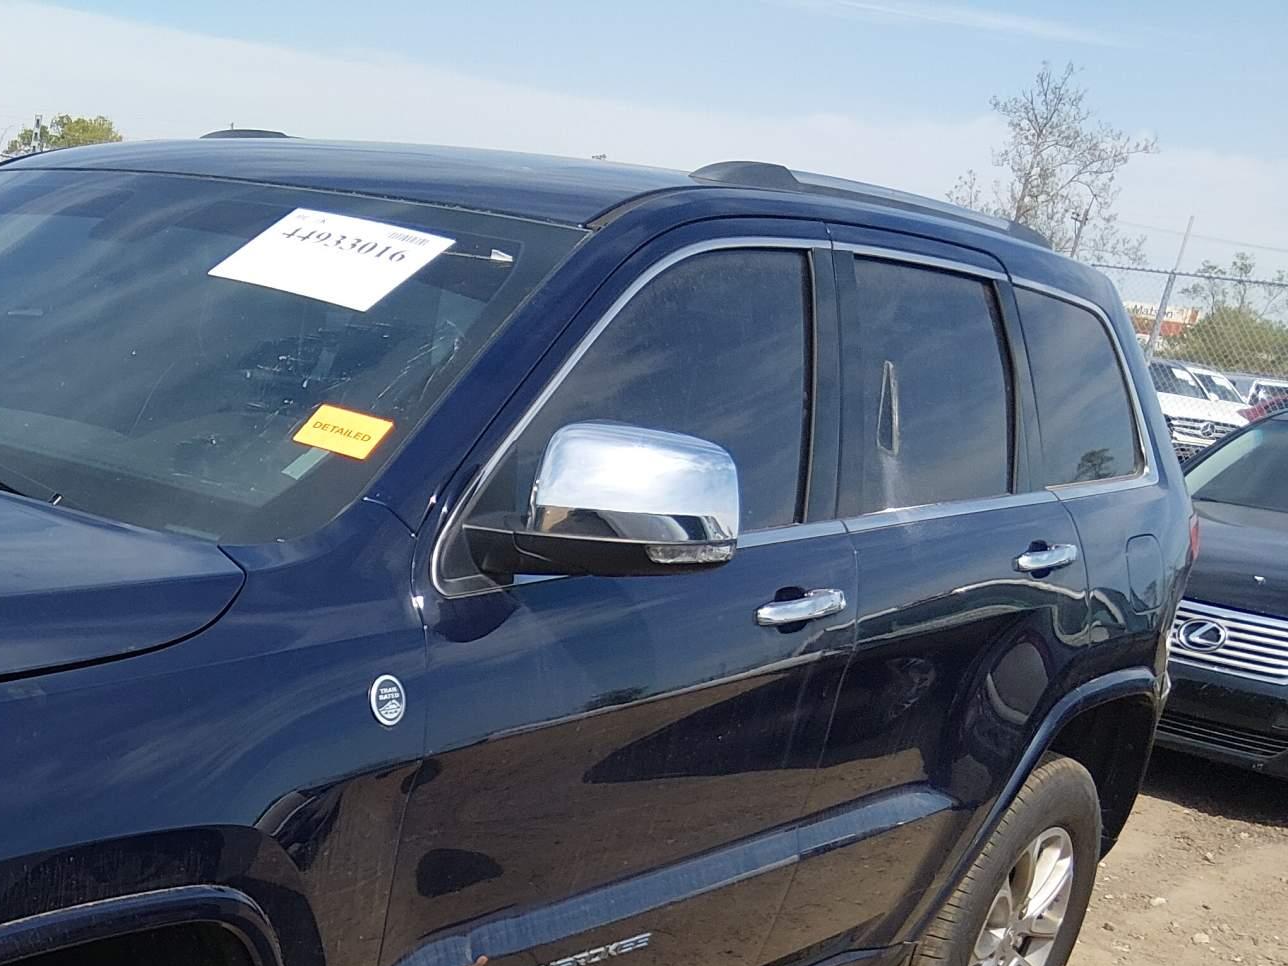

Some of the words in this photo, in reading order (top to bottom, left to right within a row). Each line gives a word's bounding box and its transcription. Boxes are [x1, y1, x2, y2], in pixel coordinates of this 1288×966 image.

[282, 227, 407, 263] 44933016
[1131, 304, 1174, 319] Matsn
[312, 420, 372, 442] DETAILED
